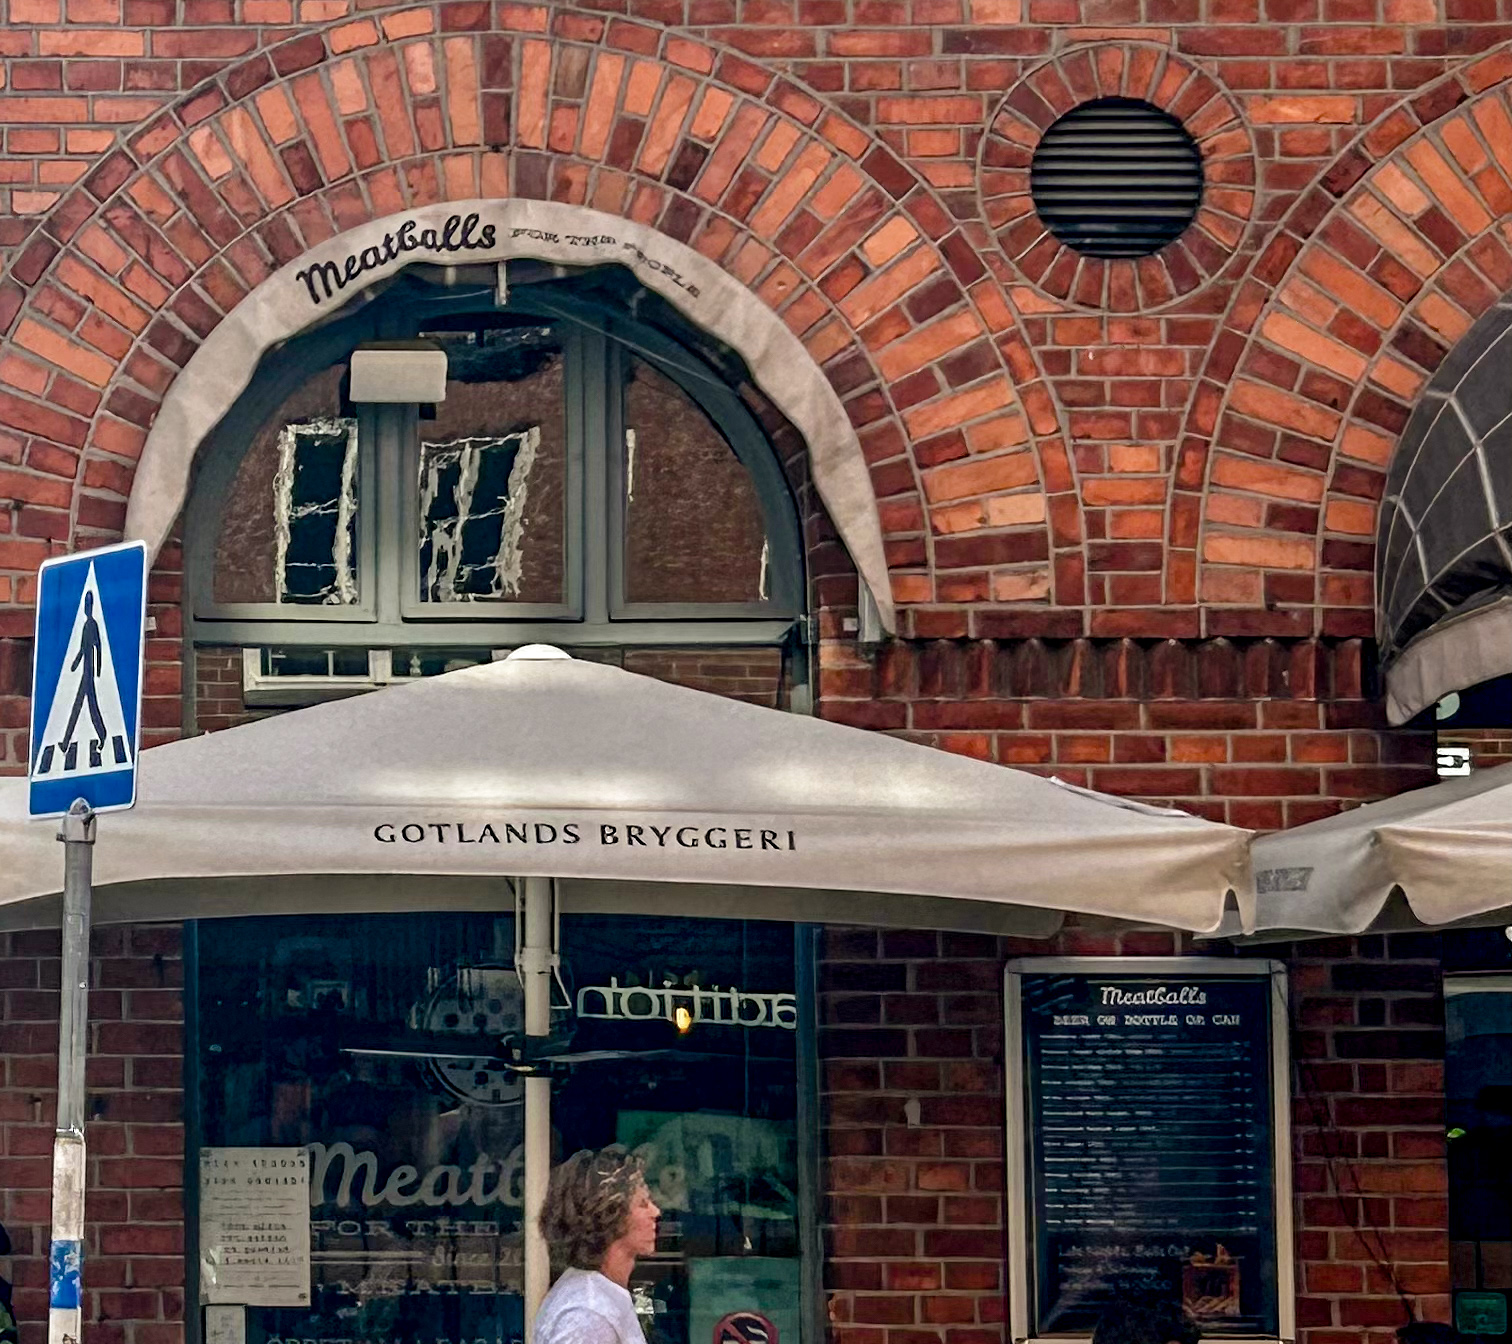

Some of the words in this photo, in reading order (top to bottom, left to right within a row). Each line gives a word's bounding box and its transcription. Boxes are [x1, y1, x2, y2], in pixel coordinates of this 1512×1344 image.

[295, 212, 497, 305] Meatballs
[374, 823, 581, 844] GOTLANDS
[600, 824, 797, 852] BRYGGERI
[1100, 986, 1207, 1005] Meatballs
